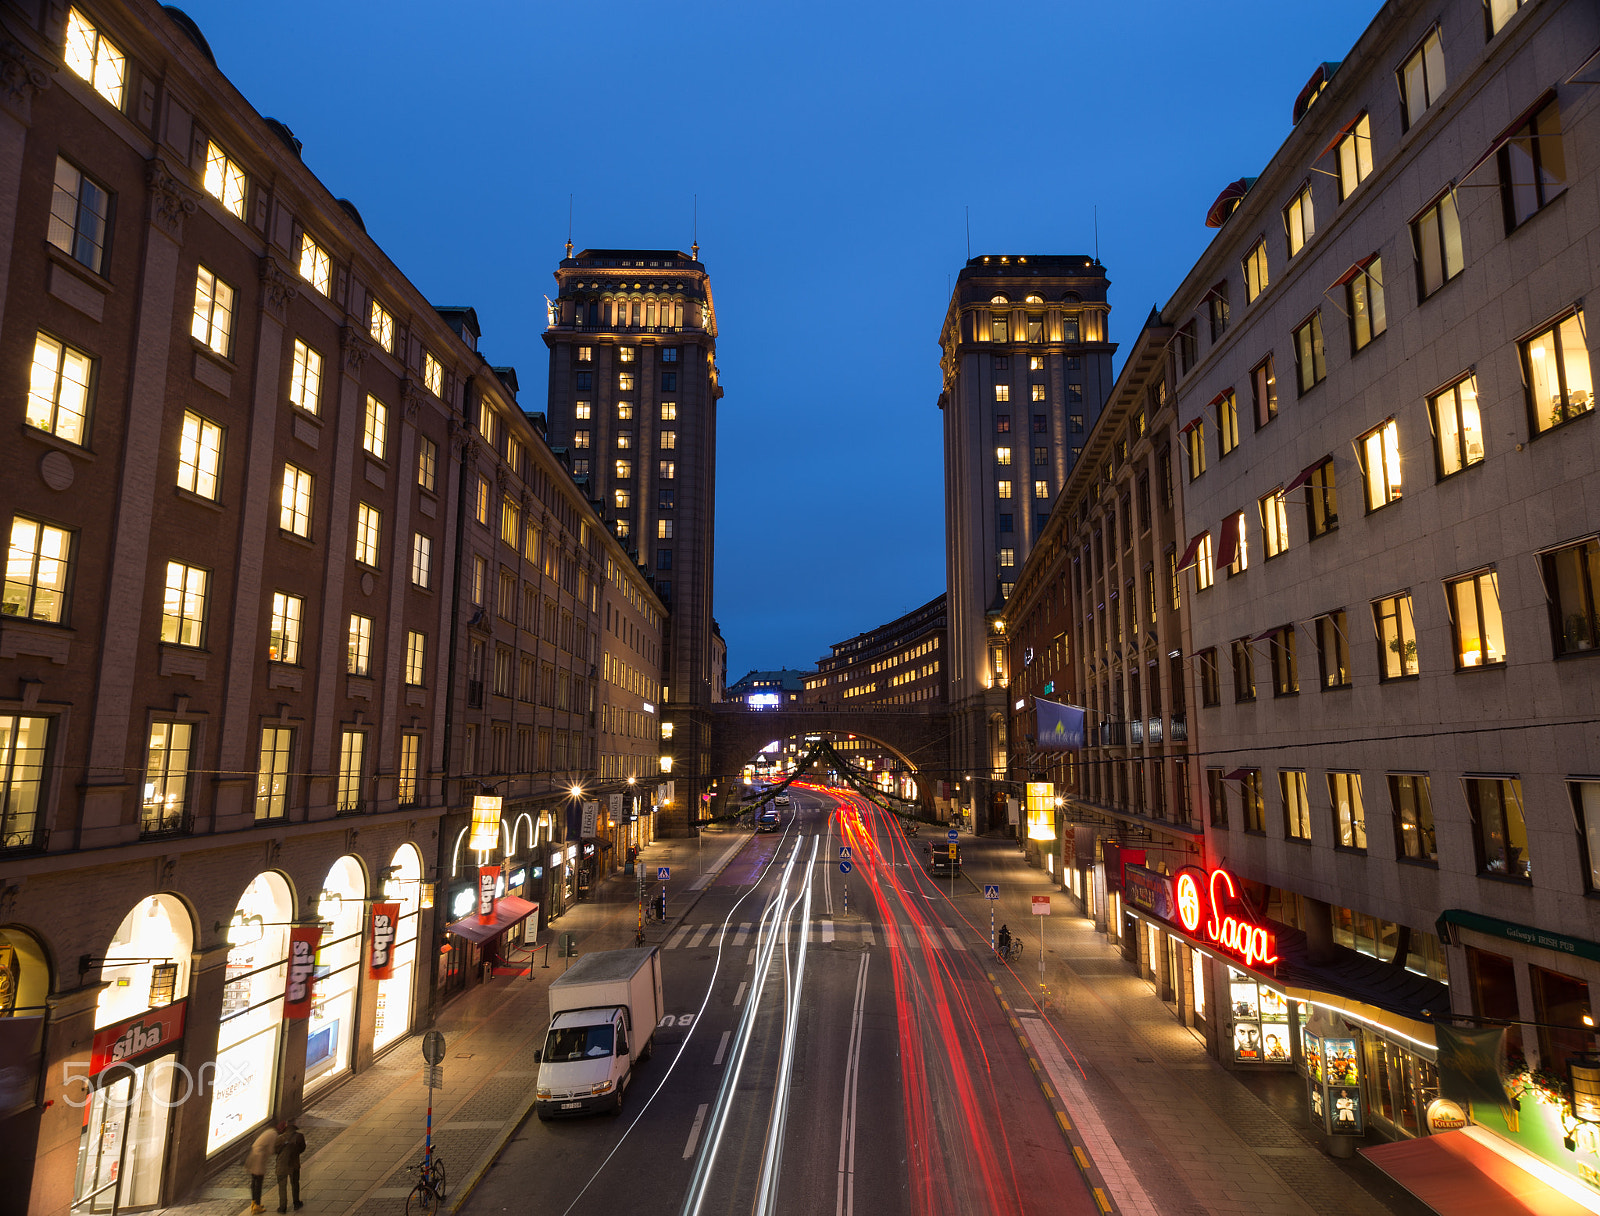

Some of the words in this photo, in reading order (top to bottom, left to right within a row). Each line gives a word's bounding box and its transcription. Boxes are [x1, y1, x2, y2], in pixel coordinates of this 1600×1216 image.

[481, 875, 496, 915] siba
[1208, 869, 1278, 966] Saga
[371, 915, 394, 967] siba
[1538, 935, 1558, 948] IRISH
[1559, 940, 1575, 952] PUB
[288, 941, 316, 1003] siba
[657, 1013, 695, 1027] BU
[111, 1023, 161, 1063] siba
[1434, 1119, 1464, 1128] KILKENNY
